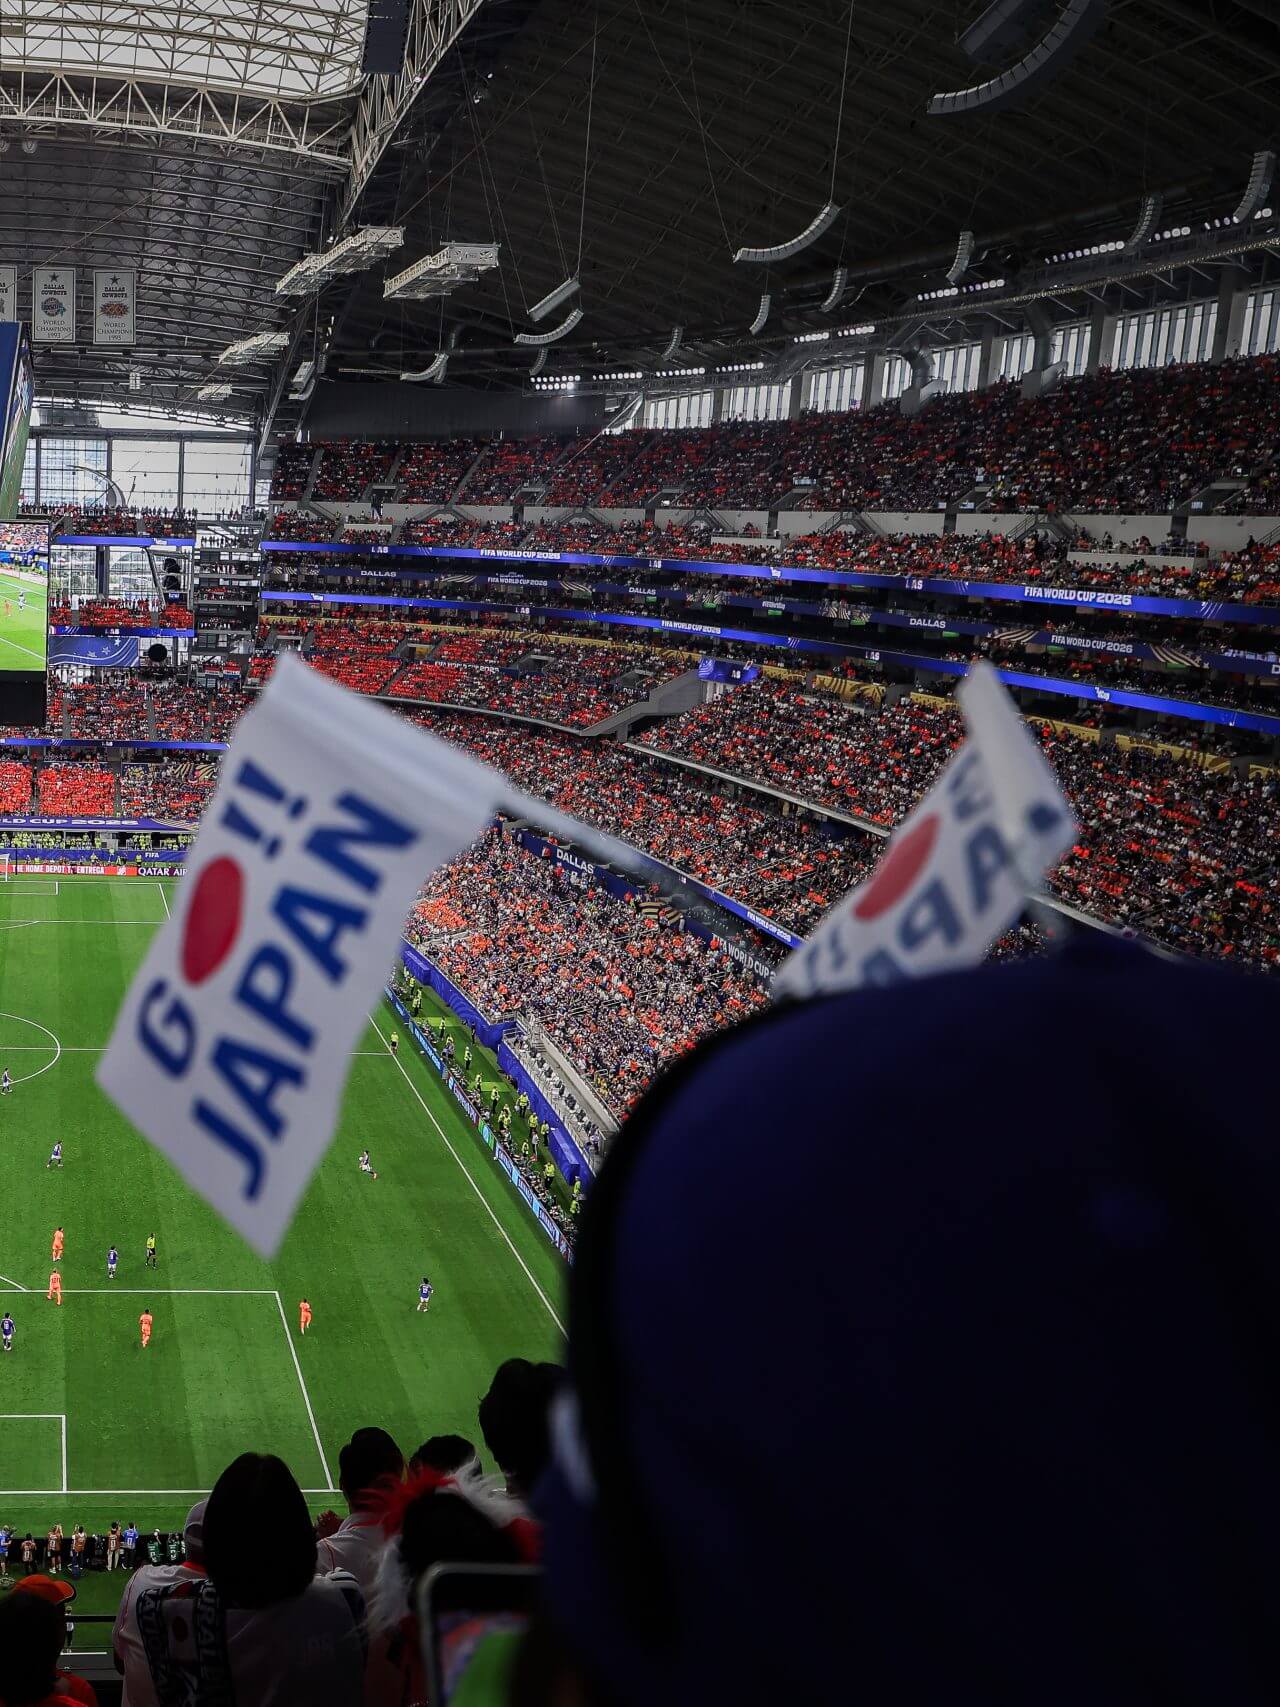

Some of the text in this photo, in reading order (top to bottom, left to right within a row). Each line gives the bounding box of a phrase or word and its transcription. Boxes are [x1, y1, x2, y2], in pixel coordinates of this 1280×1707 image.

[496, 550, 522, 558] WORLD
[522, 551, 536, 559] CUP
[536, 552, 561, 560] 2026
[360, 570, 397, 578] DALLAS
[628, 587, 657, 595] DALLAS
[1024, 586, 1132, 606] FIFA WORLD CUP 2026
[661, 620, 673, 628] FIFA
[674, 622, 691, 630] WORLD
[909, 617, 946, 629] DALLAS
[1051, 634, 1133, 653] FIFA WORLD CUP 2026
[556, 849, 594, 874] DALLAS
[26, 865, 44, 873] HOME
[45, 865, 65, 873] DEPOT
[77, 865, 105, 874] ENTREGA
[138, 867, 169, 876] QATAR
[728, 943, 754, 969] WORLD
[754, 960, 770, 978] CUP
[192, 788, 423, 1203] JAPAN
